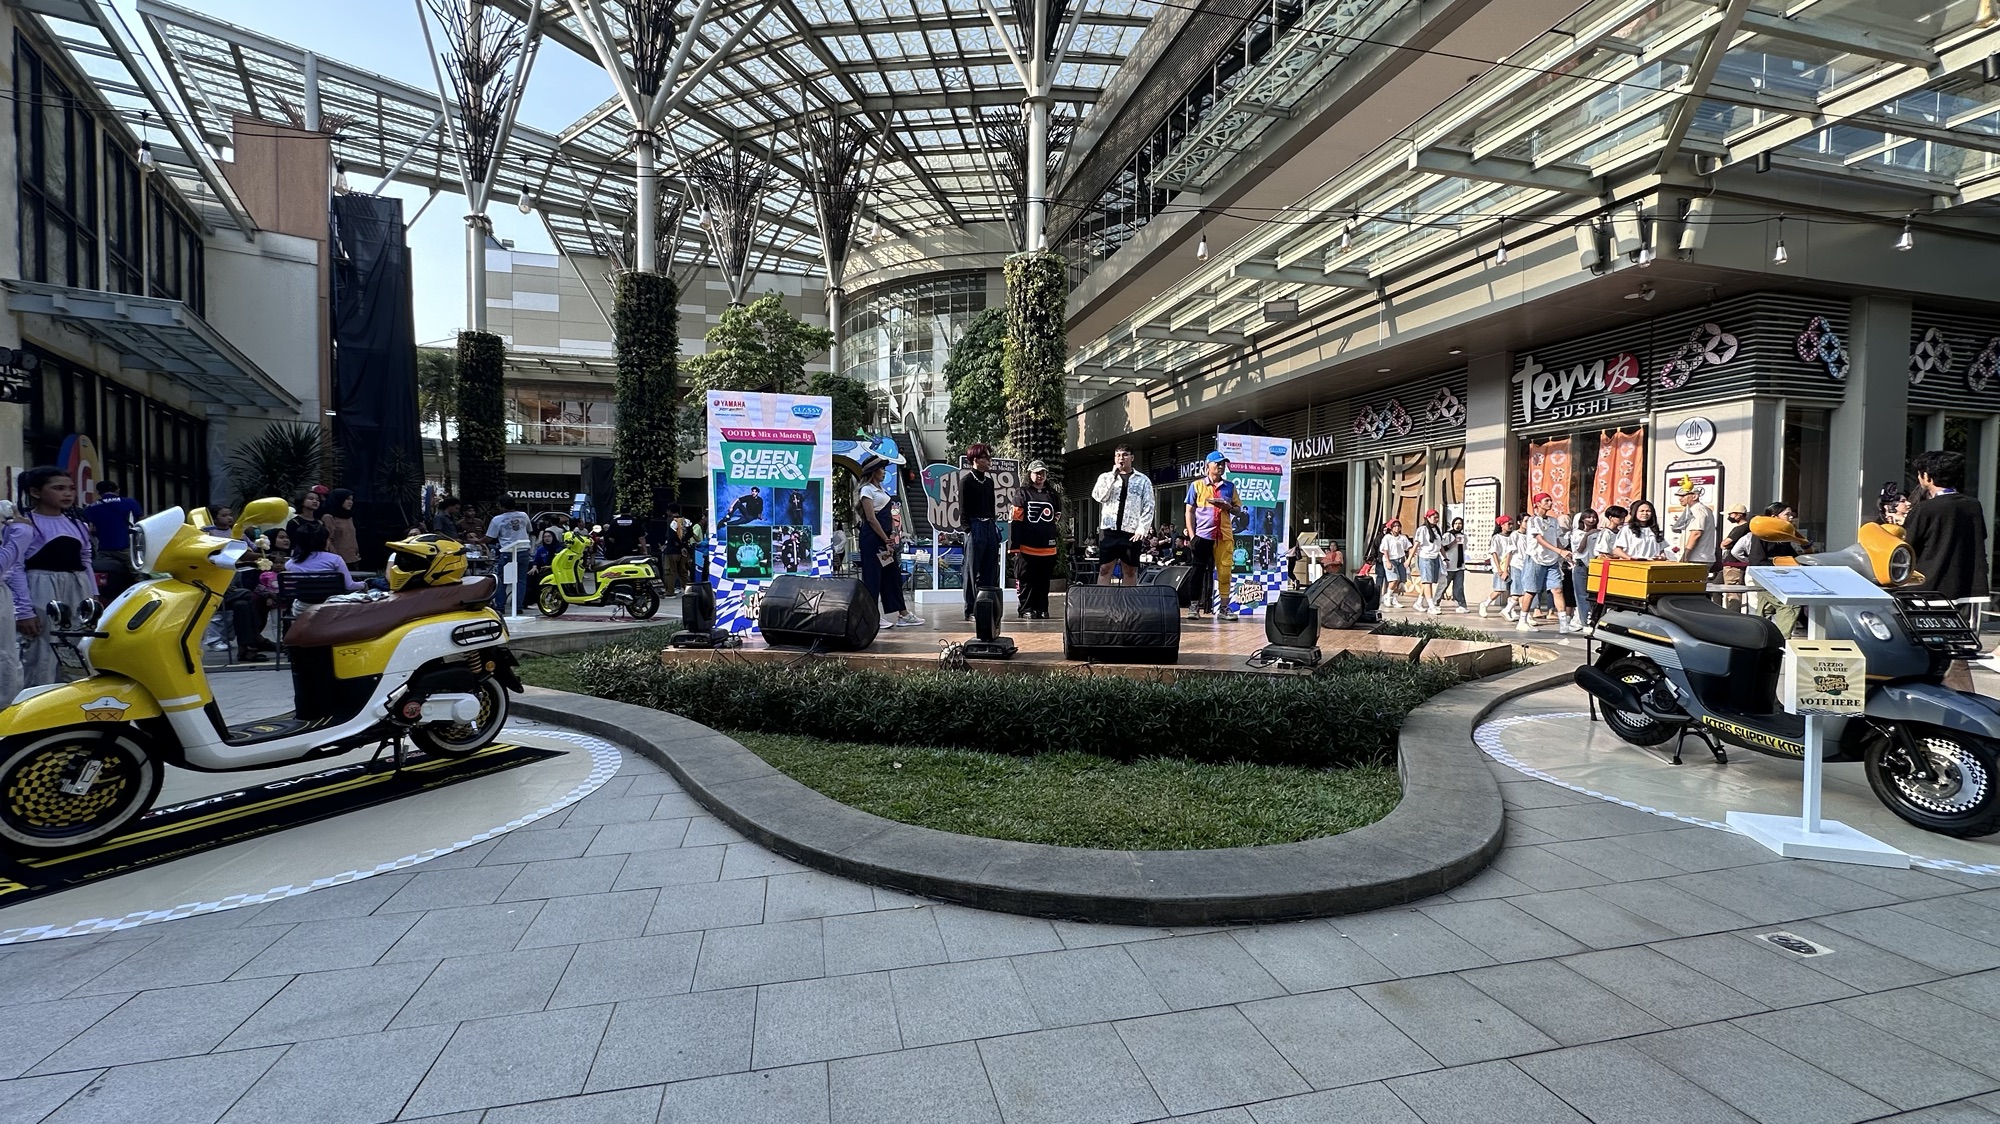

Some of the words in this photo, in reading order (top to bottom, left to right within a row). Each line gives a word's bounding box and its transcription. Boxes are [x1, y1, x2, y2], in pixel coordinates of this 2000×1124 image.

[1607, 353, 1640, 392] 友
[1551, 398, 1609, 419] SUSHI
[803, 433, 812, 441] By
[1293, 435, 1334, 459] MSUM
[730, 449, 799, 464] QUEEN
[730, 464, 780, 479] BEER
[1232, 478, 1272, 490] QUEEN
[507, 490, 570, 499] STARBUCKS
[1800, 698, 1829, 706] VOTE
[1831, 699, 1861, 707] HERE
[1734, 726, 1776, 748] SUPPLY
[1951, 752, 1979, 786] KATROS
